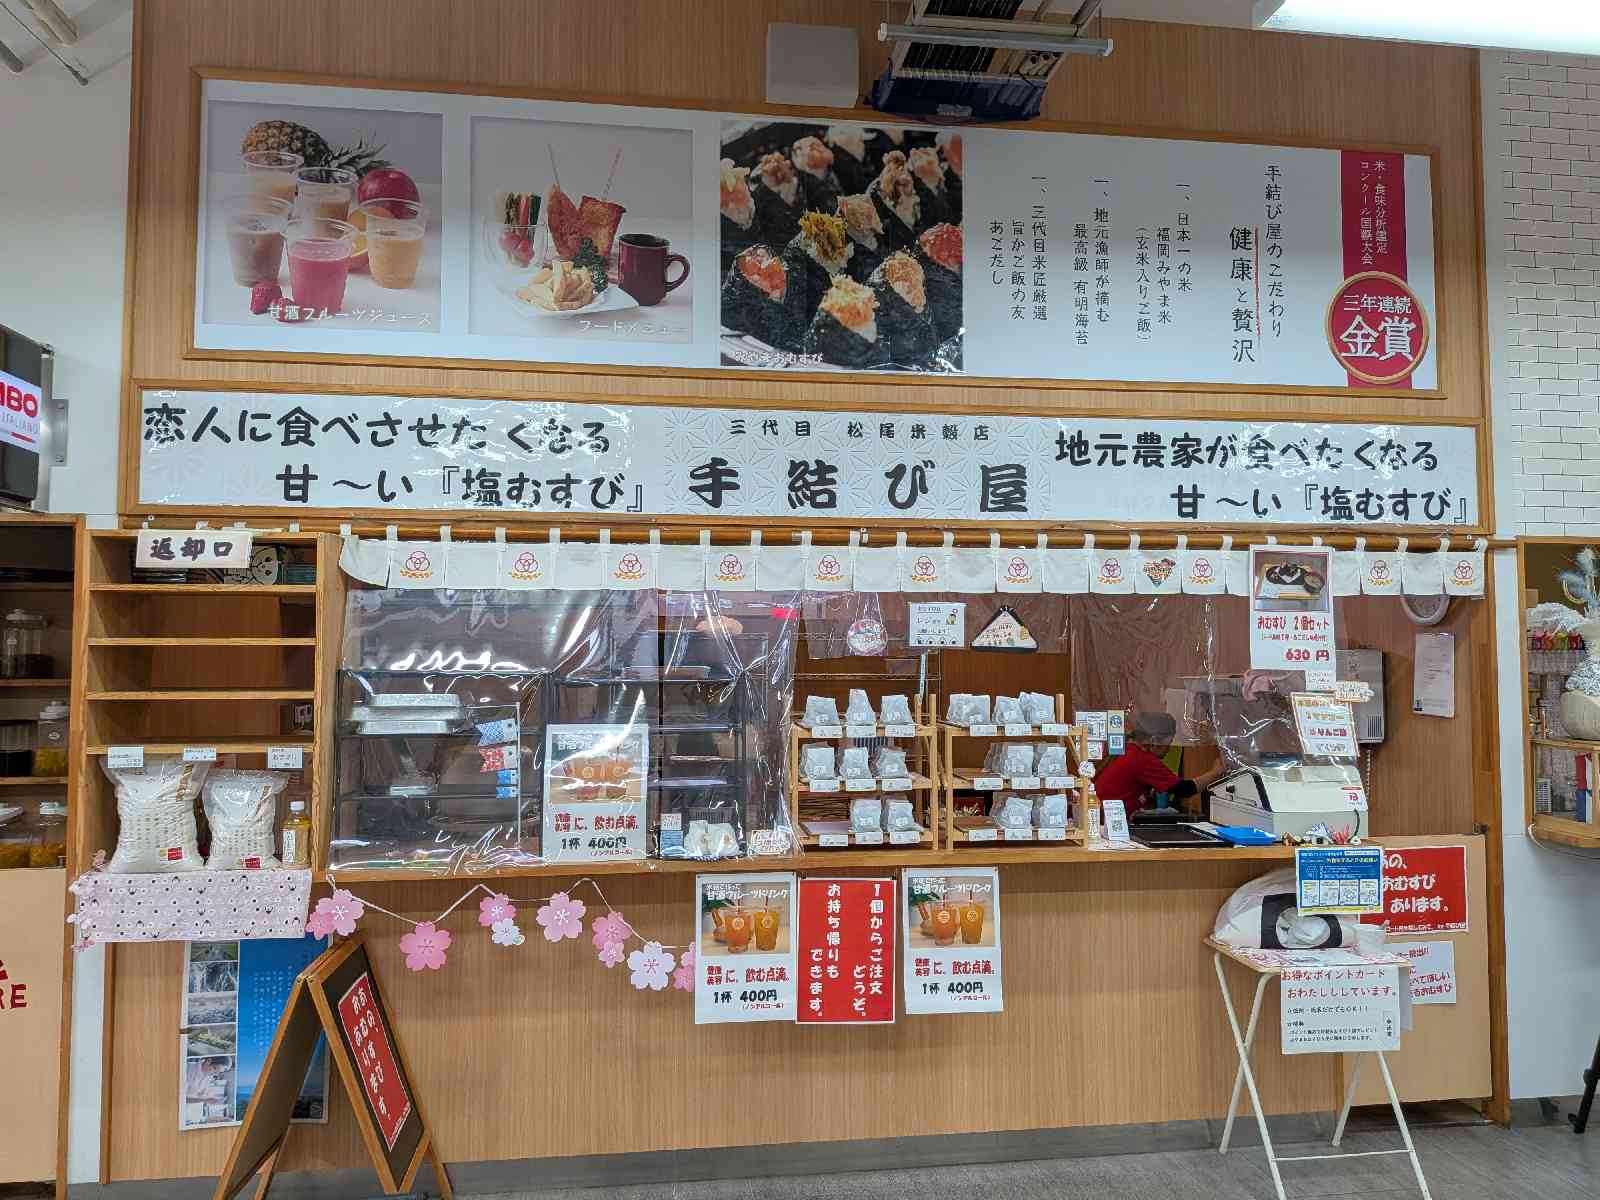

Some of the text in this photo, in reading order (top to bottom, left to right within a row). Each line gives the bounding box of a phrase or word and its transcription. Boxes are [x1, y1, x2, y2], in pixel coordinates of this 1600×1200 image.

[1264, 165, 1284, 338] 手結び屋のこだわり
[1011, 220, 1026, 321] 旨かご飯の友
[1156, 226, 1171, 324] 福岡みやま米
[1229, 226, 1256, 363] 健康と贅沢
[1343, 294, 1412, 314] 三年連続
[268, 304, 432, 327] 甘酒フルーツジュース
[1340, 314, 1416, 361] 金賞
[0, 382, 38, 417] BO
[730, 419, 811, 437] 三代目
[689, 456, 1027, 513] 手結び屋
[150, 537, 233, 561] 返却口
[1285, 648, 1330, 661] 630 円
[1390, 896, 1449, 913] あります。
[827, 883, 841, 979] お持ち帰りも
[809, 948, 823, 1017] できます。
[922, 981, 984, 995] 1杯 400円
[1281, 968, 1385, 981] お得なポイントカード
[713, 989, 778, 1004] 1杯 400円
